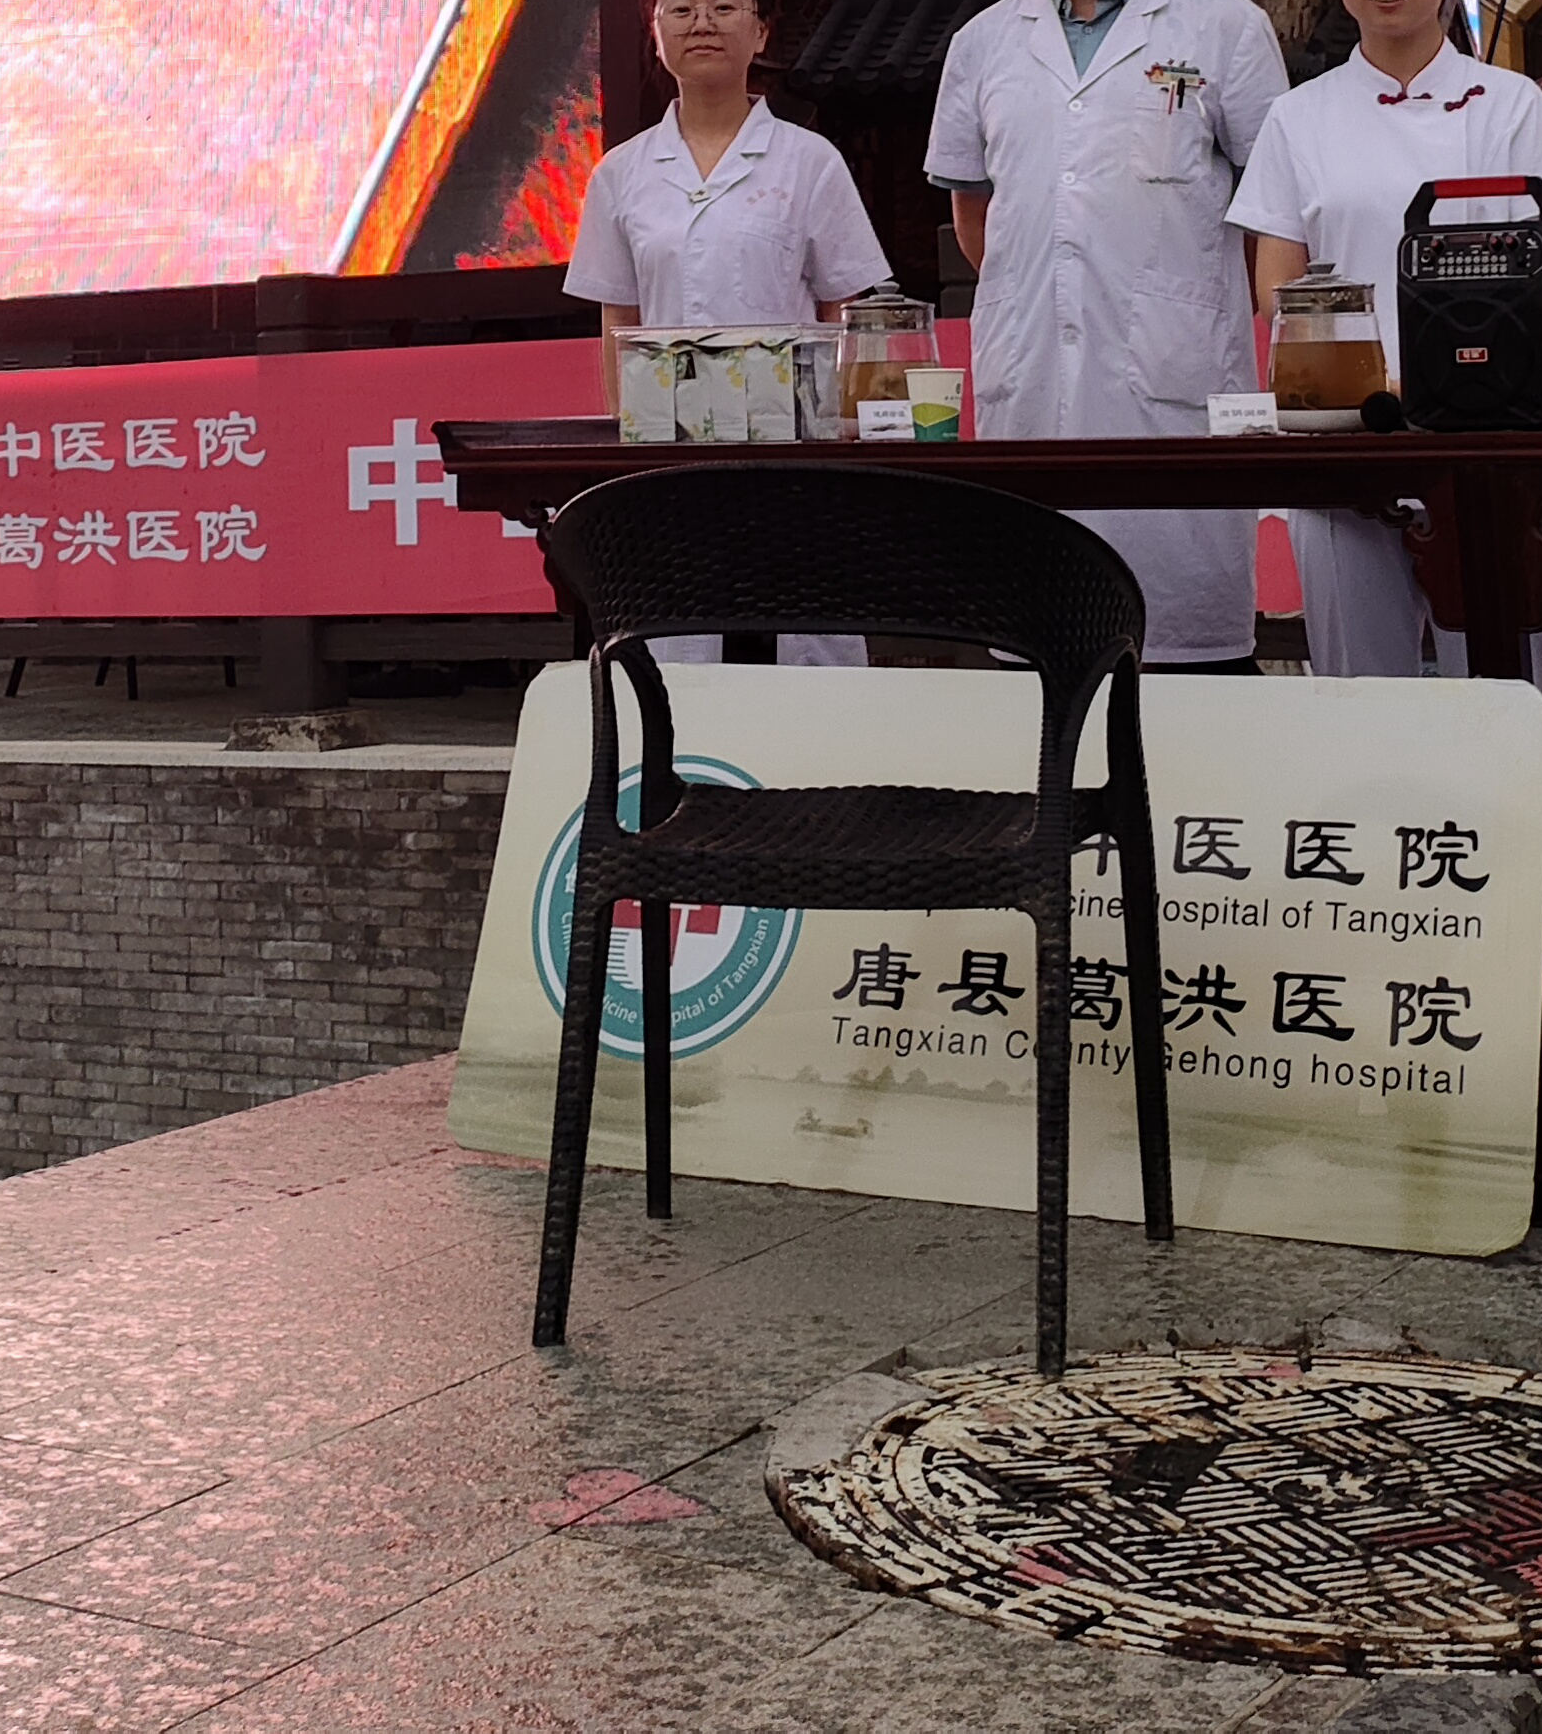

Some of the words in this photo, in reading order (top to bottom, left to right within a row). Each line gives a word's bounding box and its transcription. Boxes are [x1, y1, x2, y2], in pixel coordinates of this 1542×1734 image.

[1156, 894, 1269, 930] ospital
[1283, 901, 1312, 929] of
[1325, 901, 1482, 943] Tangxian
[708, 984, 725, 1006] of
[723, 917, 770, 991] Tangxian
[832, 942, 1483, 1052] 唐县葛洪医院
[832, 1016, 988, 1057] Tangxian
[1005, 1030, 1131, 1075] Cnty
[1310, 1053, 1465, 1097] hospital
